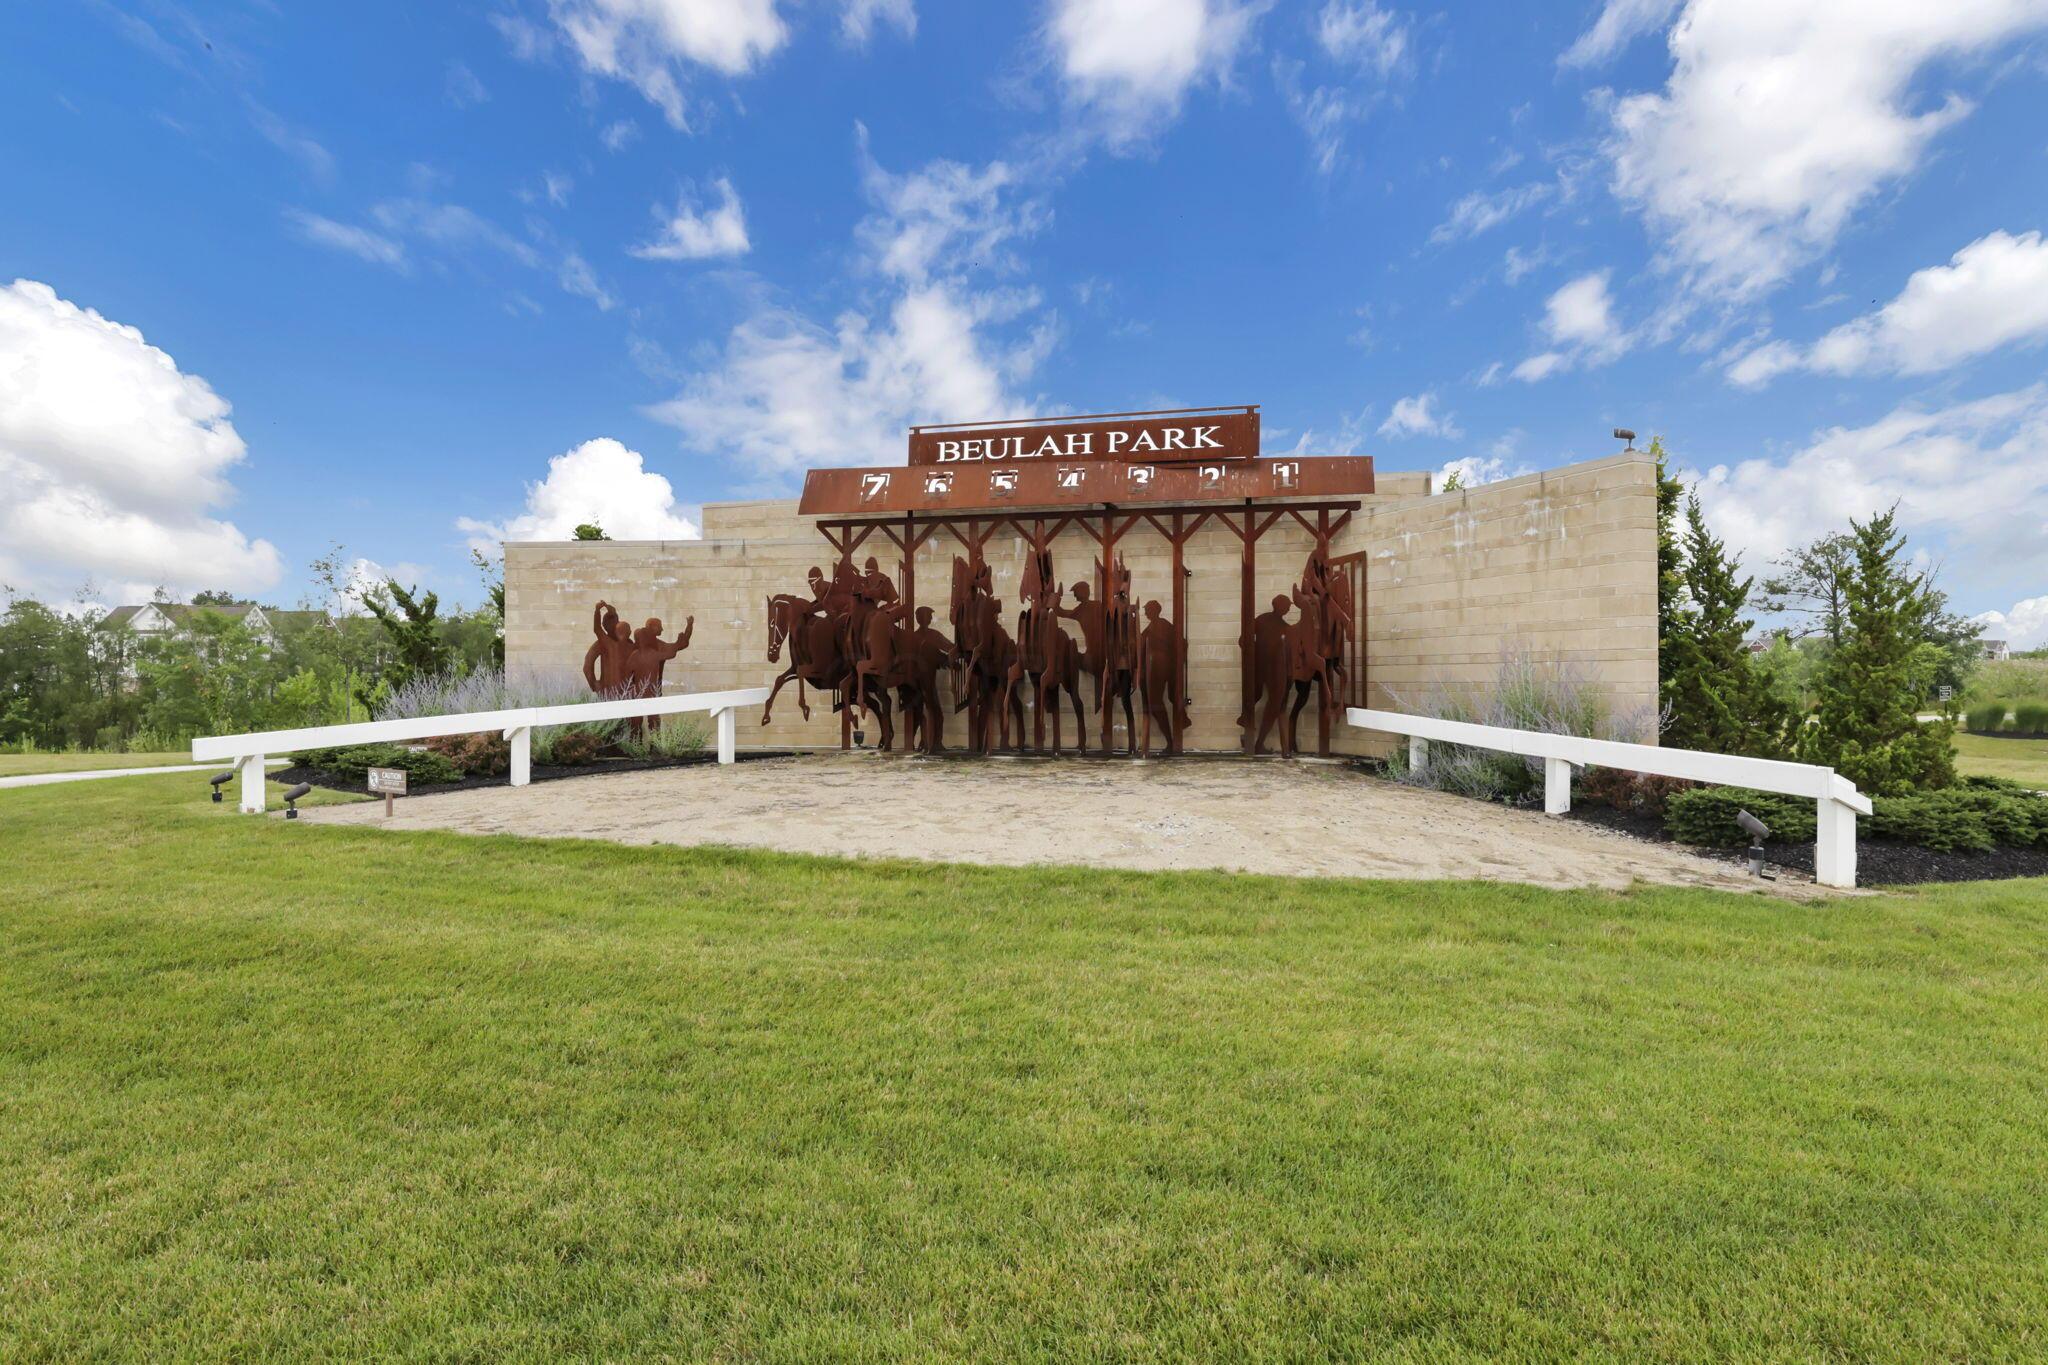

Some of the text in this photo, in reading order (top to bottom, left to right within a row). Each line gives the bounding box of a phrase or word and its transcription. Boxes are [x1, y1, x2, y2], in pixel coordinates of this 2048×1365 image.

[936, 425, 1225, 462] BEULAH PARK
[865, 465, 1294, 501] 7 6 5 4 3 2 1
[381, 771, 402, 780] CAUTION
